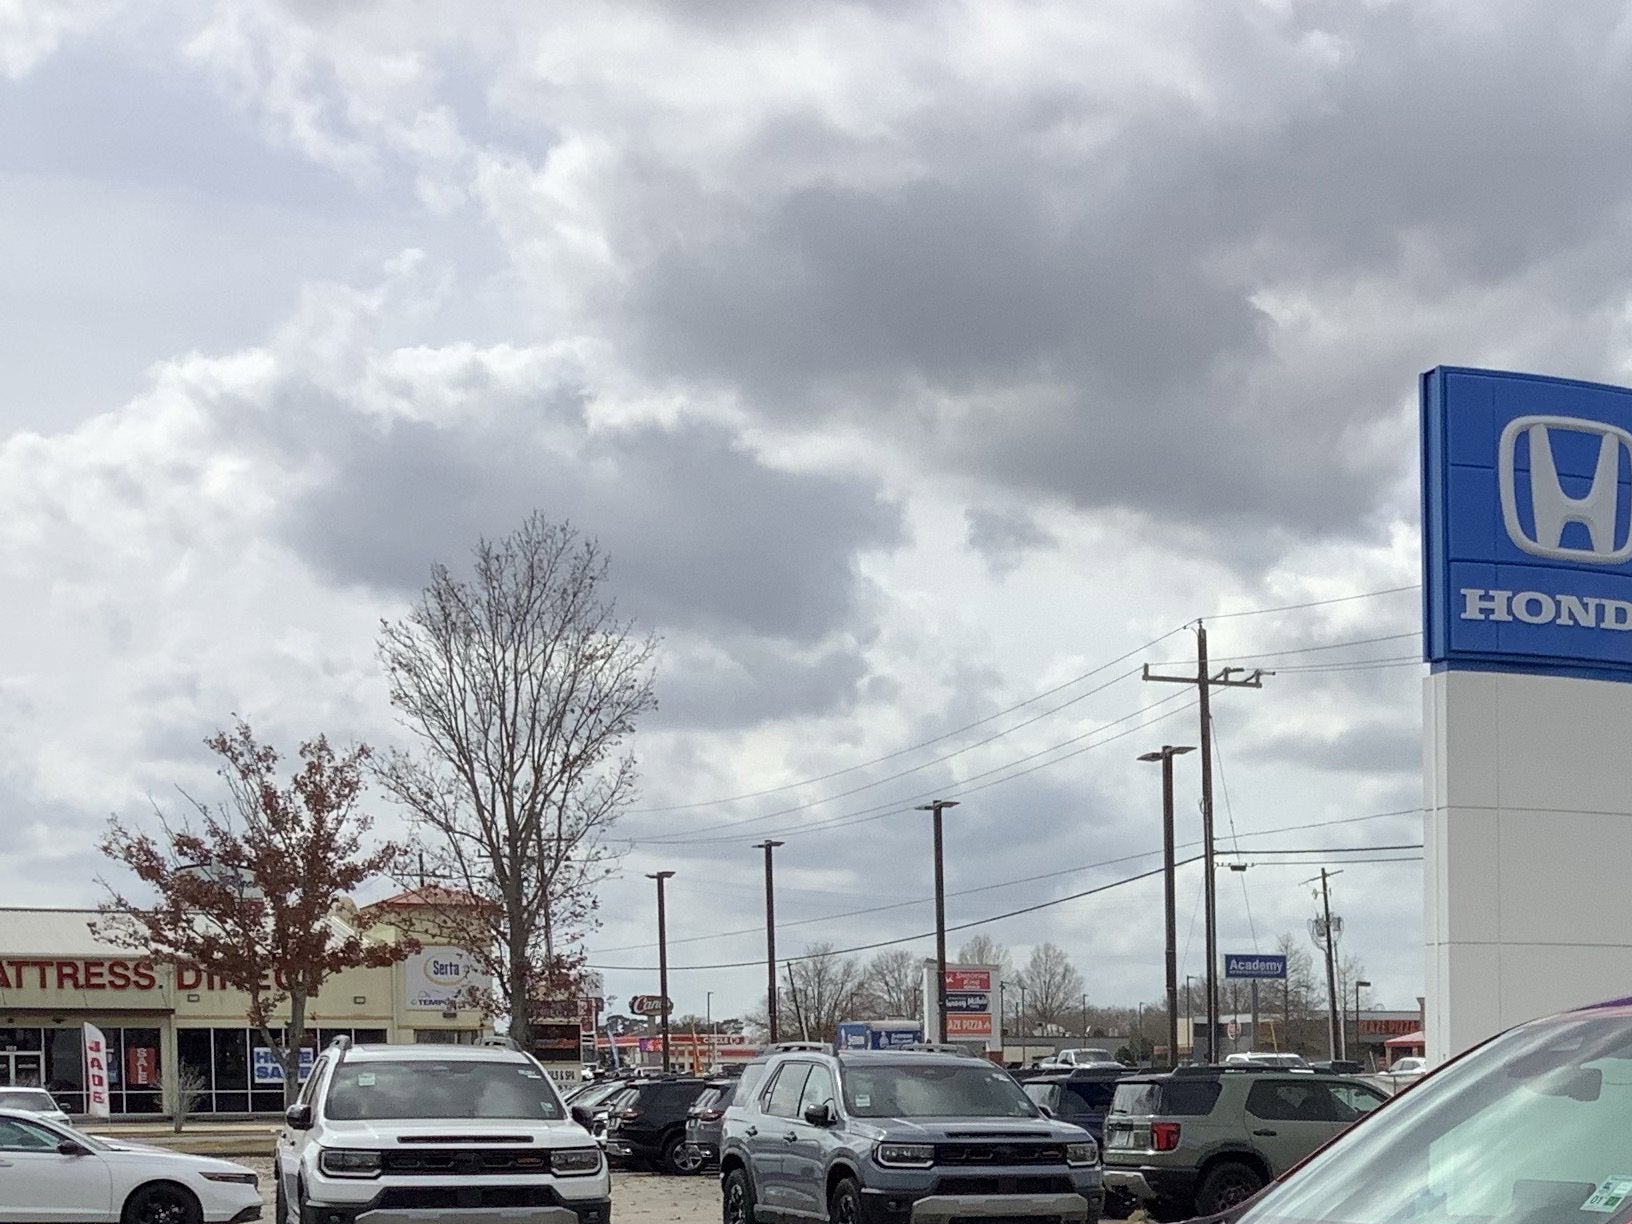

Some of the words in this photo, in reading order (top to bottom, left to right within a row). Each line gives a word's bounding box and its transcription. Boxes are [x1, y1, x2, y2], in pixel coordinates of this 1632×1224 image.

[433, 960, 460, 976] Serta
[1230, 959, 1284, 974] Academy
[962, 1020, 984, 1030] PIZZA
[88, 1039, 106, 1104] JADE
[136, 1047, 149, 1085] SALE
